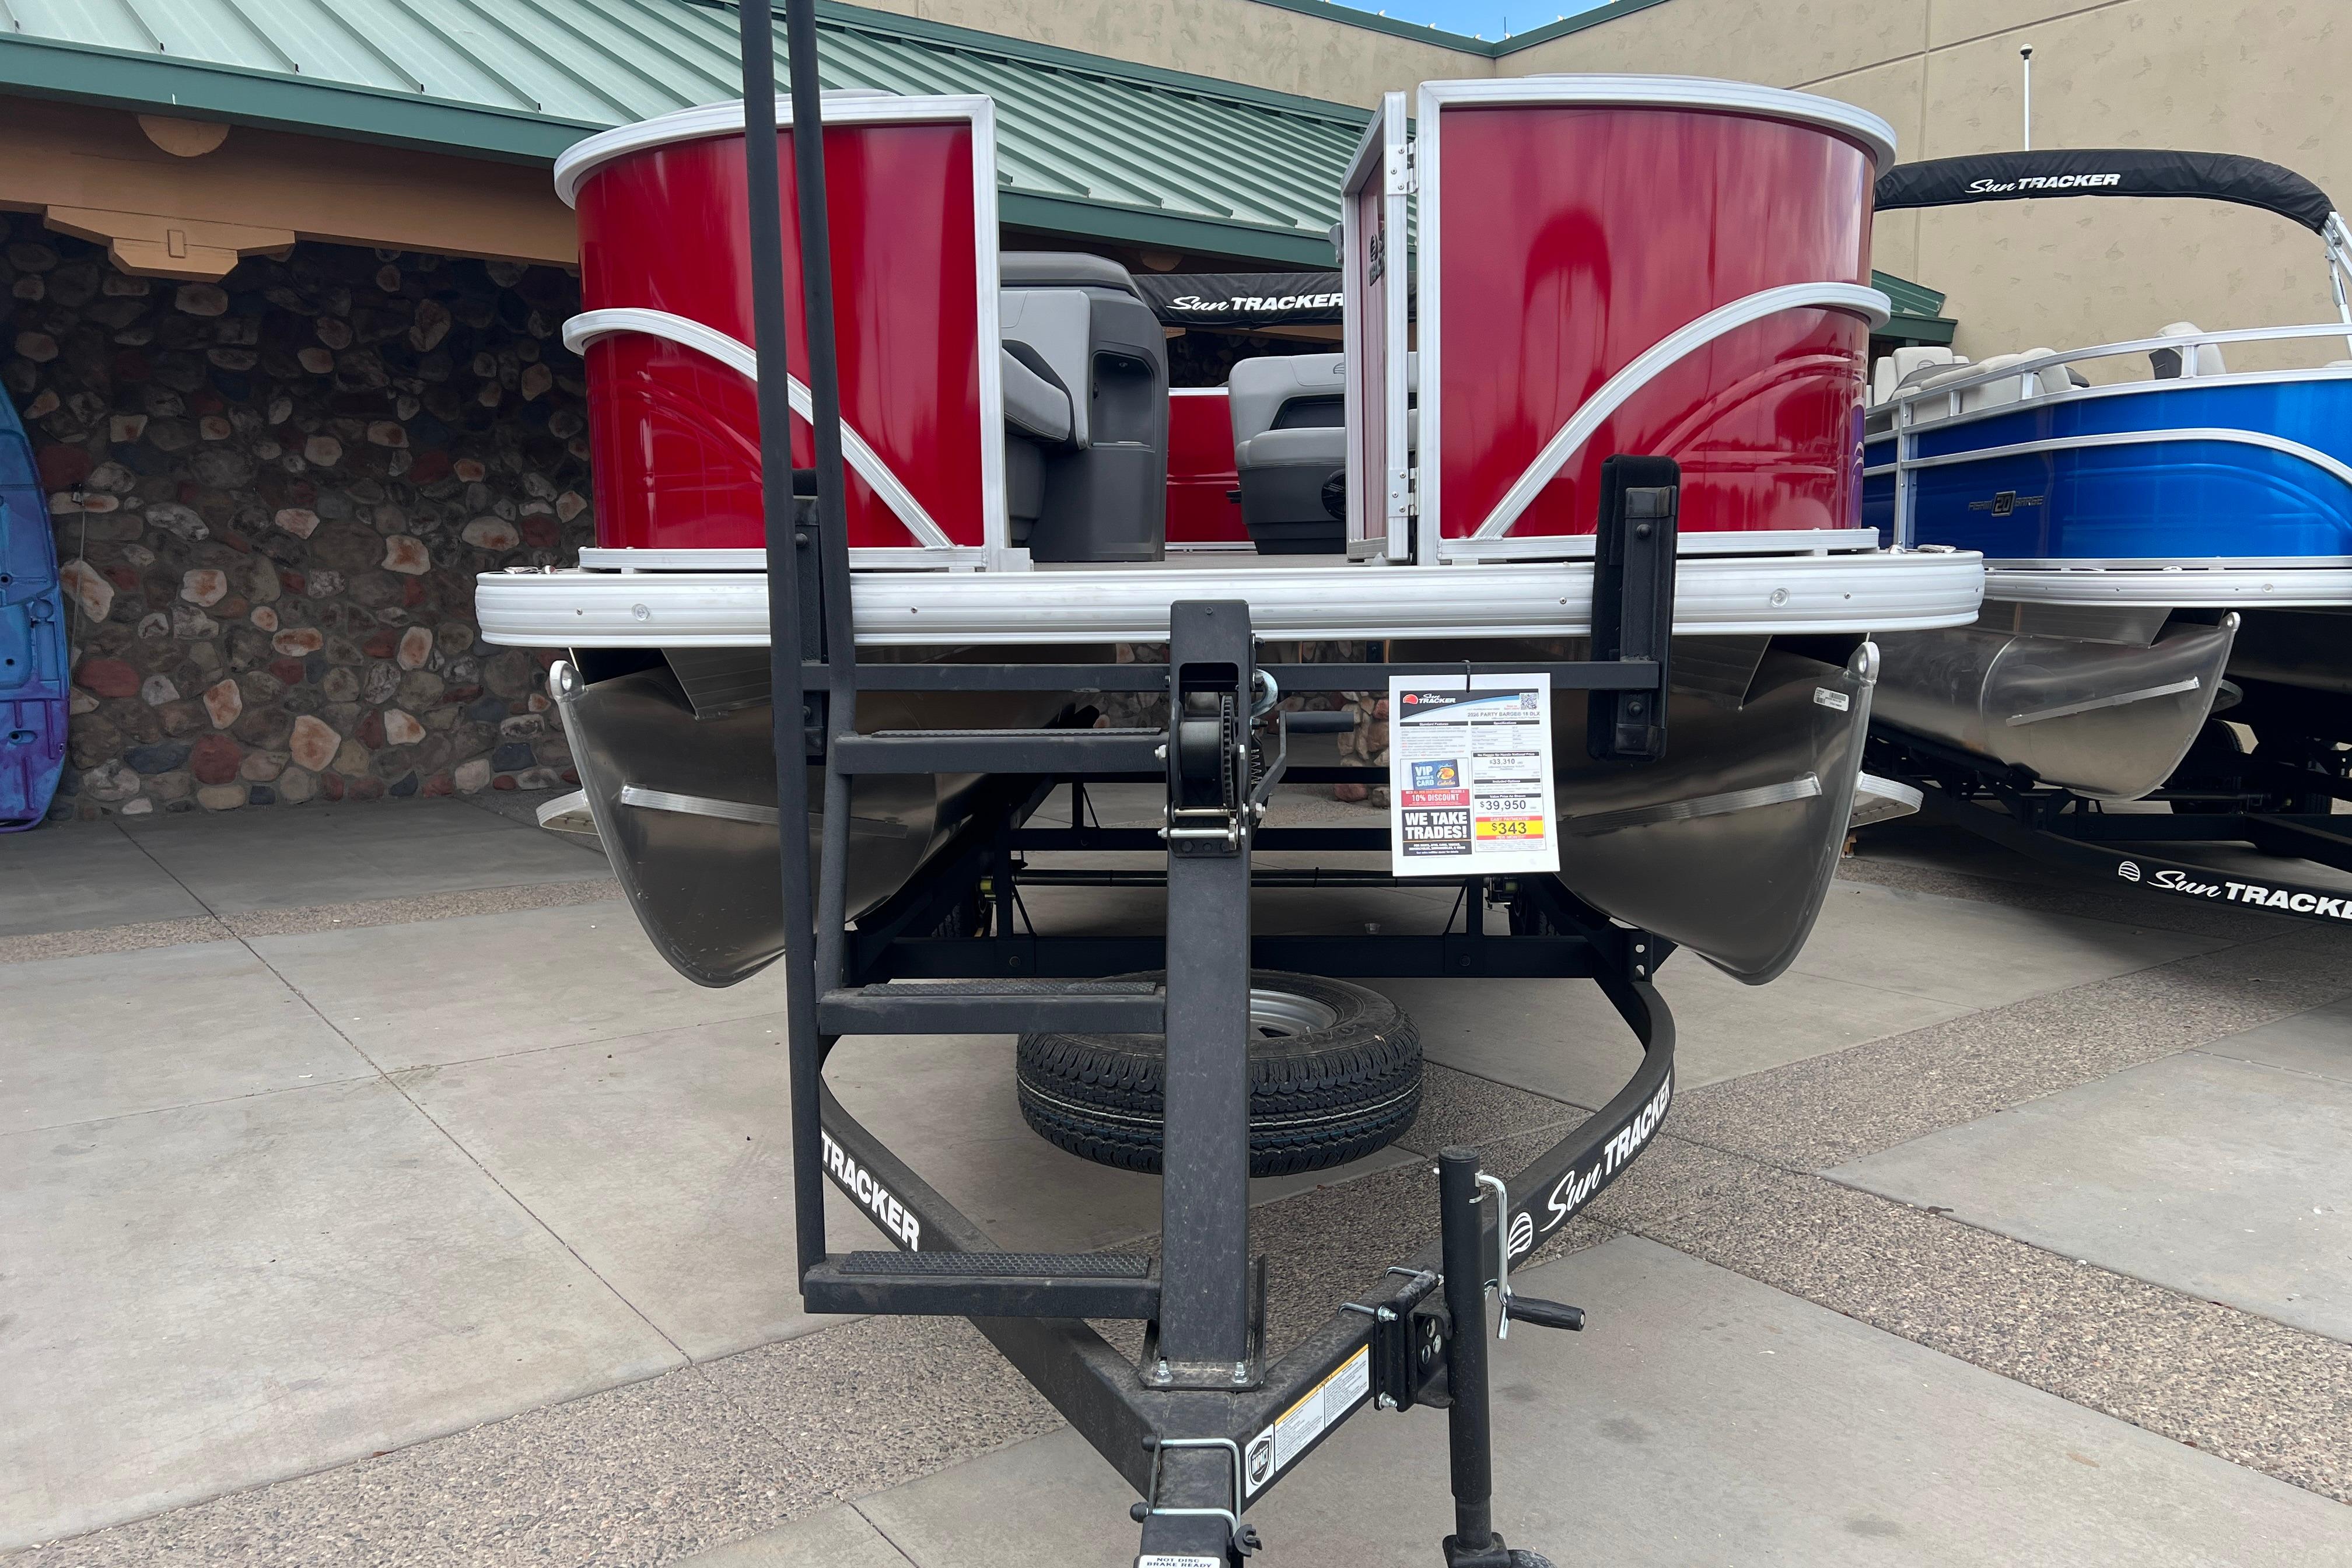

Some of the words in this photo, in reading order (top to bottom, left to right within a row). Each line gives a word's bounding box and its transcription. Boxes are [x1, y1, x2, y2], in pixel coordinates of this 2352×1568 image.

[1965, 179, 2017, 193] Sun
[2018, 174, 2120, 190] TRACKER
[1166, 296, 1229, 311] Sun
[1231, 293, 1343, 311] TRACKER
[1995, 497, 2011, 512] 20
[1415, 766, 1433, 776] VIP
[1480, 800, 1526, 811] $39,950
[1405, 812, 1428, 825] WE
[1430, 811, 1467, 825] TAKE
[1405, 825, 1467, 839] TRADES!
[1492, 822, 1527, 835] $343
[2147, 870, 2221, 897] Sun
[1540, 1163, 1602, 1232] Sun
[1604, 1067, 1671, 1175] TRACKER
[821, 1130, 920, 1252] TRACKER
